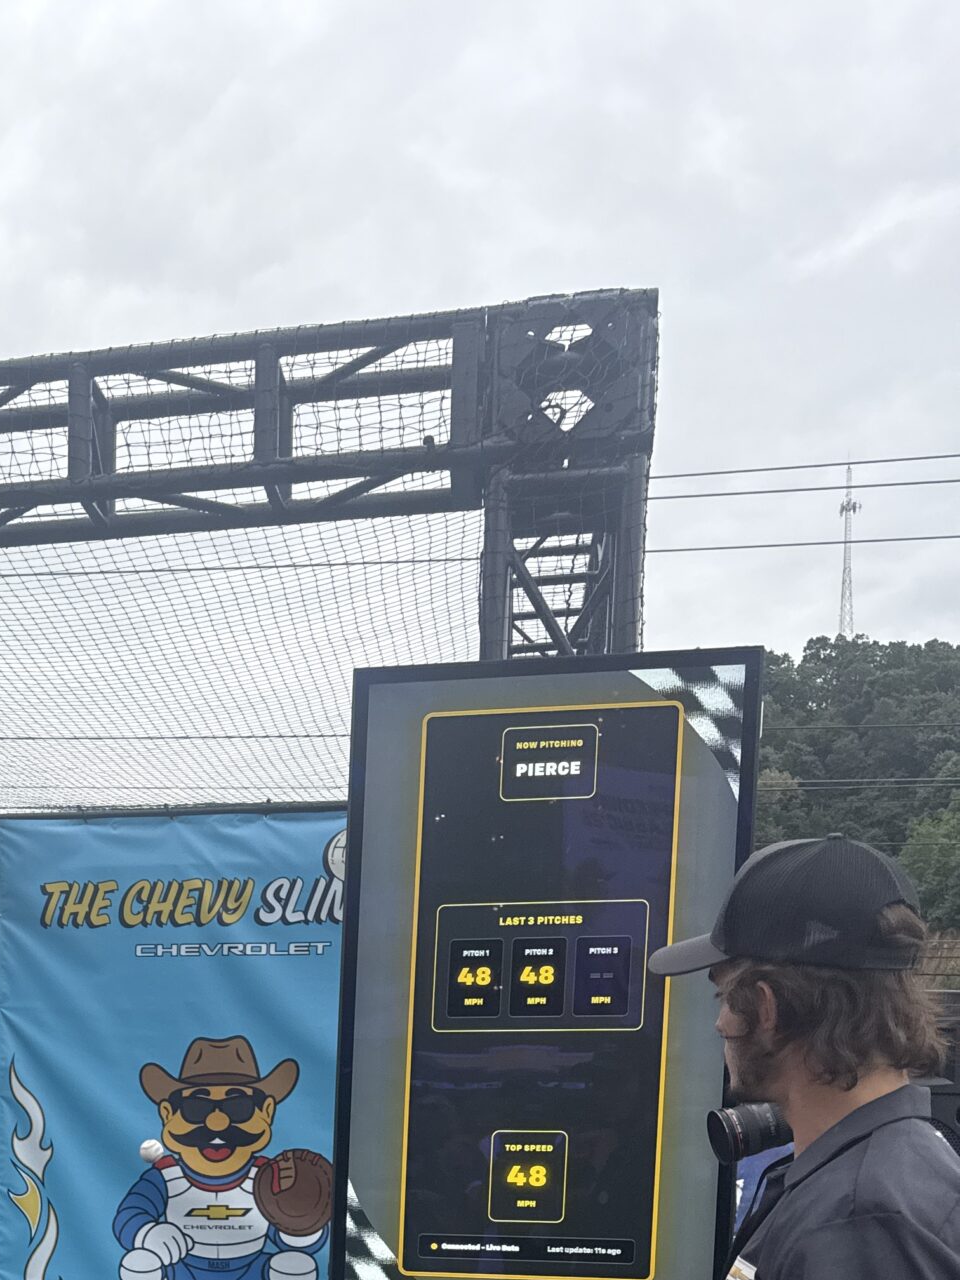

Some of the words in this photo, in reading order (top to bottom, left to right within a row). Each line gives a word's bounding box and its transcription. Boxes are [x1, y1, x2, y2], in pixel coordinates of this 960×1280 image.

[516, 741, 538, 750] NOW
[539, 739, 584, 749] PITCHING
[515, 761, 581, 777] PIERCE
[41, 880, 117, 929] THE
[118, 876, 253, 928] CHEVY
[499, 916, 526, 926] LAST
[527, 916, 535, 925] 3
[537, 915, 584, 925] PITCHES
[135, 941, 332, 957] CHEVROLET
[462, 949, 485, 957] PITCH
[524, 948, 547, 956] PITCH
[589, 947, 612, 955] PITCH
[457, 966, 491, 986] 48
[520, 965, 555, 985] 48
[464, 998, 484, 1006] MPH
[527, 997, 547, 1005] MPH
[591, 996, 611, 1004] MPH
[505, 1144, 523, 1152] TOP
[524, 1144, 554, 1152] SPEED
[507, 1165, 547, 1187] 48
[516, 1200, 537, 1208] MPH
[547, 1245, 564, 1253] Last
